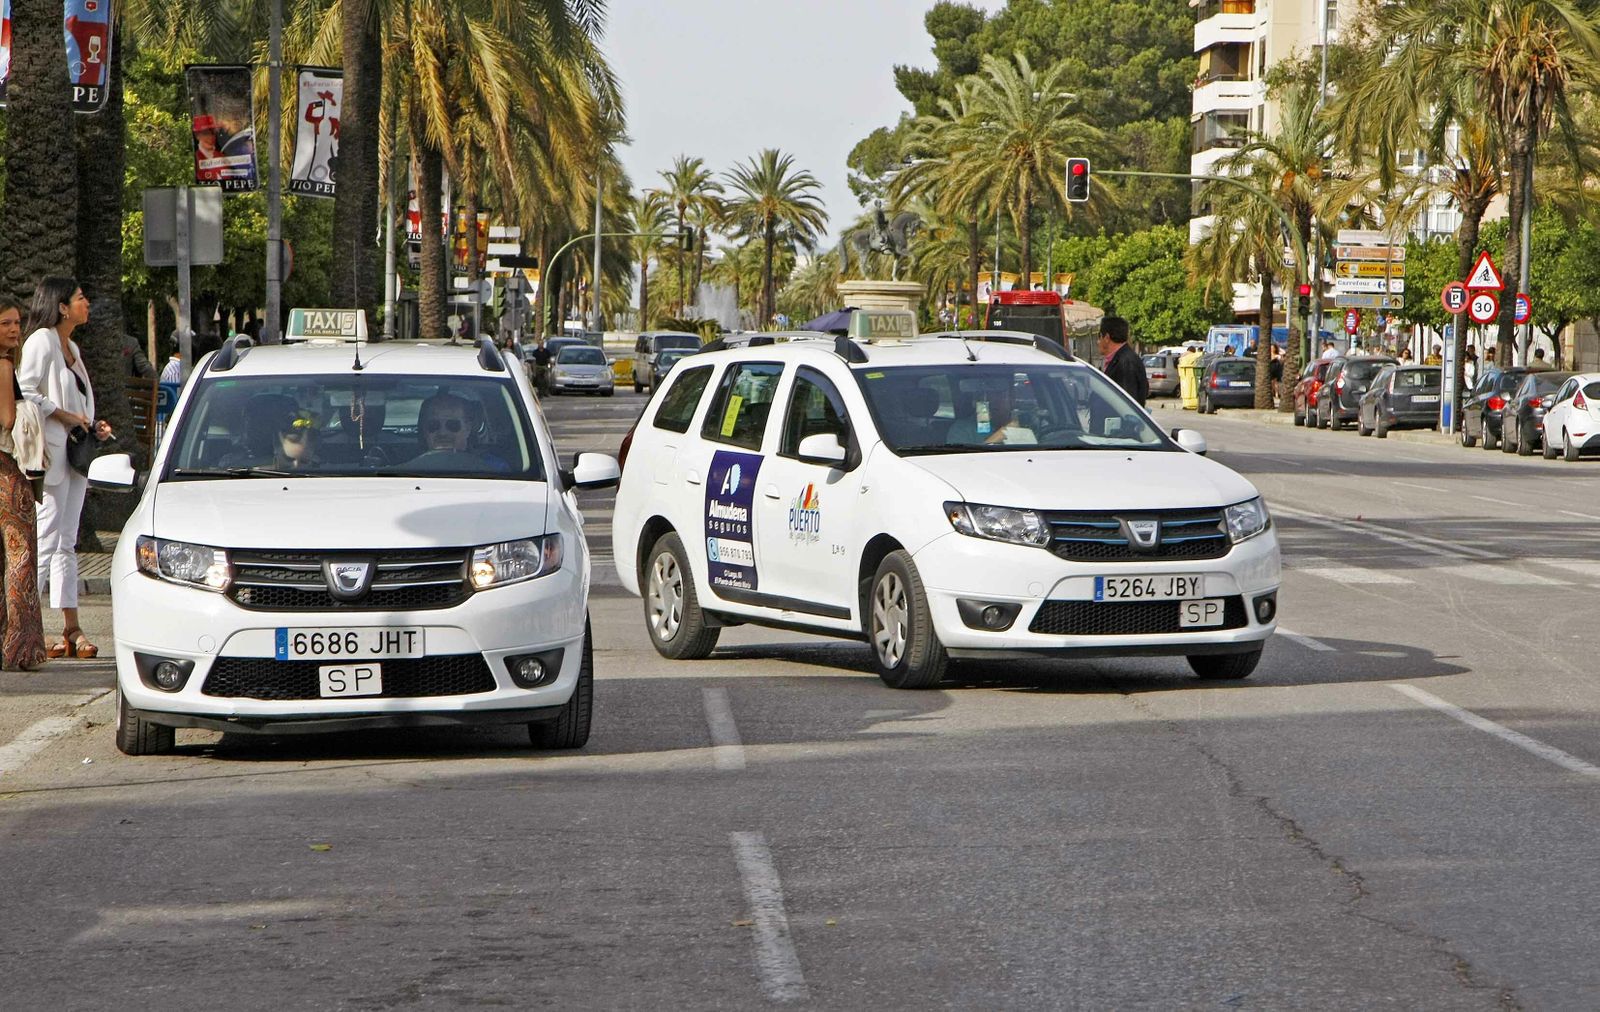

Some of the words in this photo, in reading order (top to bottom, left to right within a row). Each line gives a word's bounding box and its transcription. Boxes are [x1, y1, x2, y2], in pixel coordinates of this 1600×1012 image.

[225, 179, 254, 190] PEPE
[292, 180, 311, 190] TIO
[1474, 302, 1492, 312] 30
[304, 311, 342, 329] TAXI
[868, 315, 900, 331] TAXI
[708, 499, 748, 522] Almudena
[708, 520, 748, 534] seguros
[788, 508, 820, 533] PUERTO
[1107, 578, 1156, 598] 5264
[1164, 578, 1198, 596] JBY
[1188, 603, 1218, 623] SP
[294, 632, 358, 655] 6686
[370, 631, 416, 654] JHT
[328, 668, 373, 692] SP
